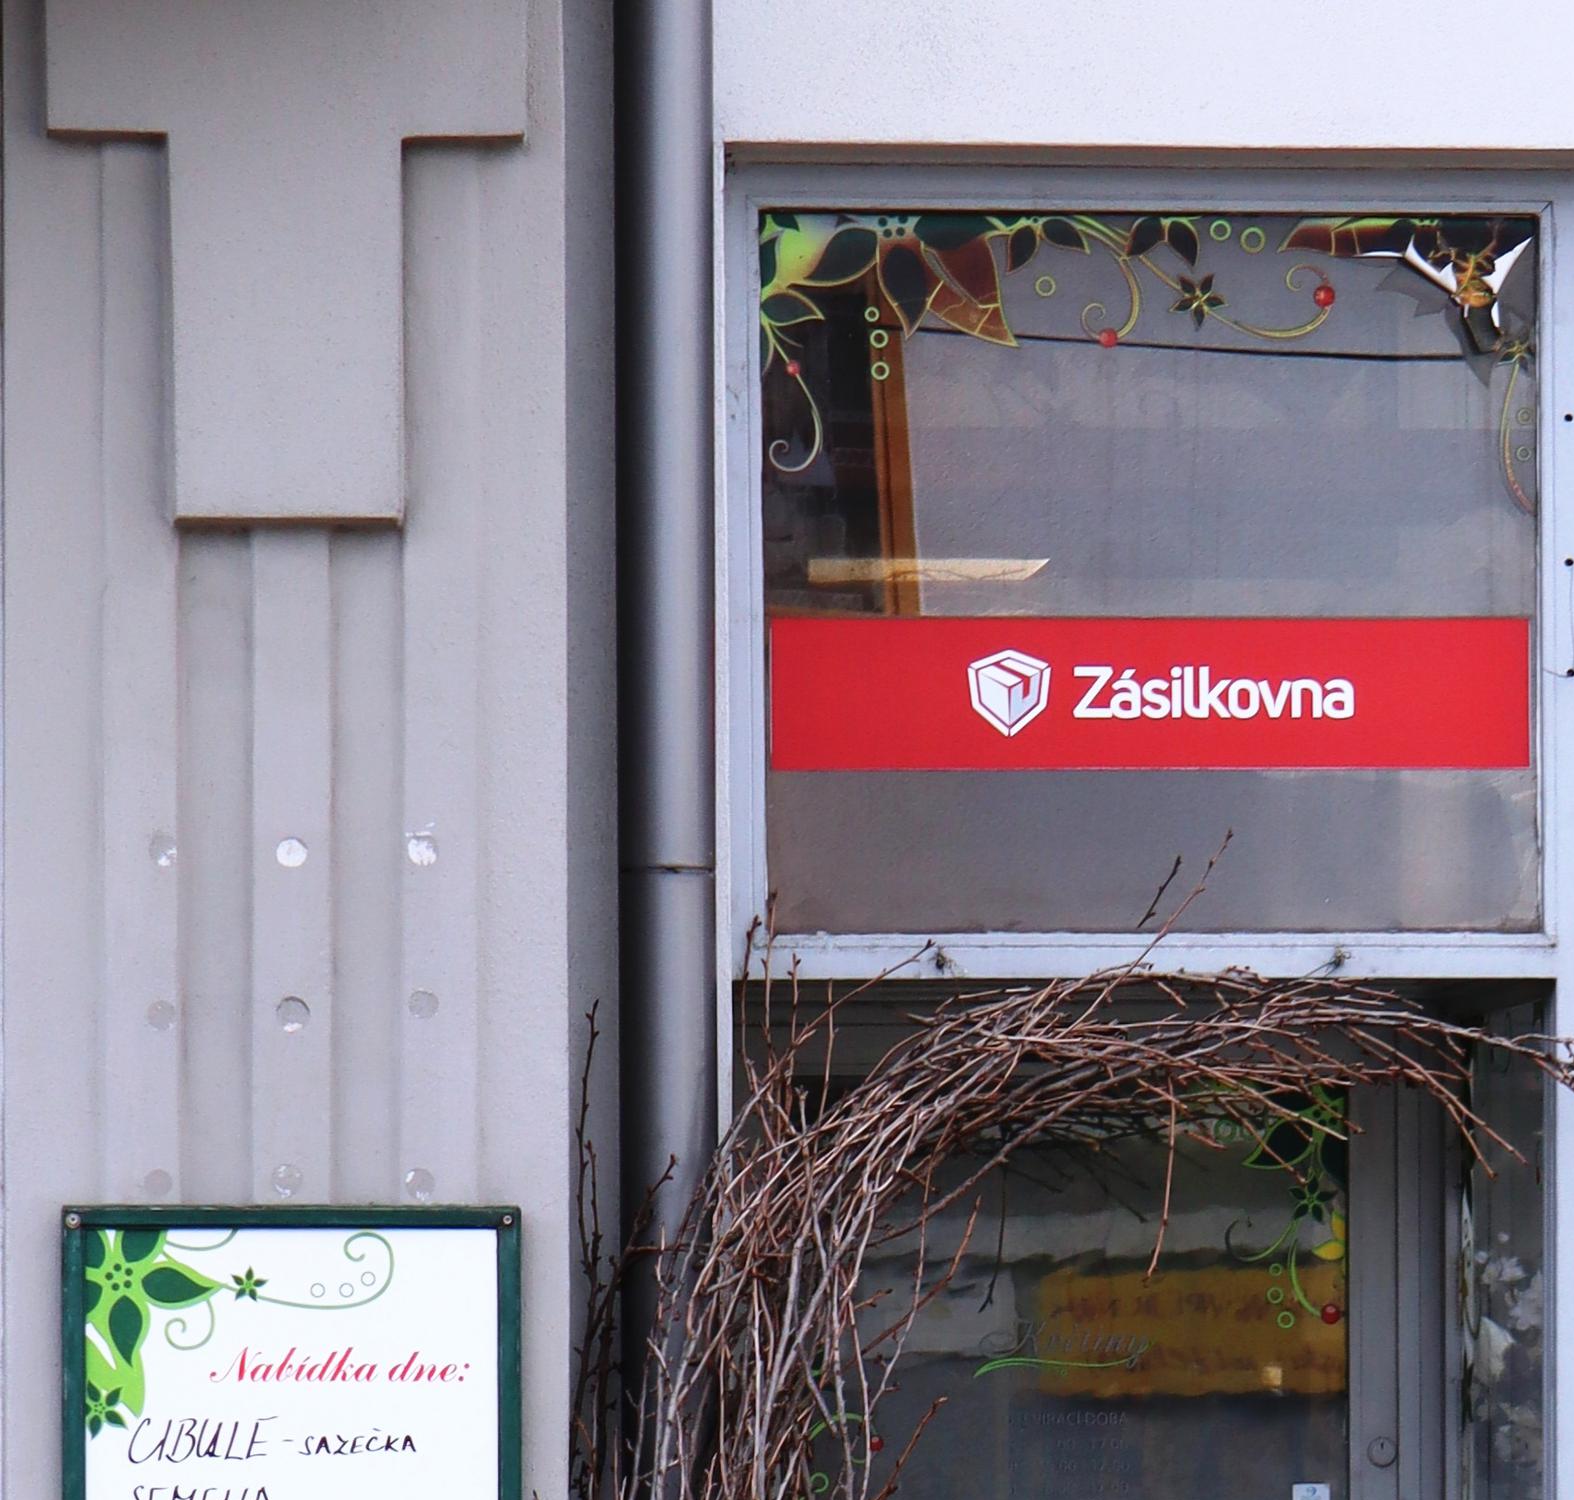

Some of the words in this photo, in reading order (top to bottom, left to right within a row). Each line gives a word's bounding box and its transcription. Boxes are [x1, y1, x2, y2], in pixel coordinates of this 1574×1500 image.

[1072, 666, 1355, 719] Zásilkovna
[210, 1347, 377, 1383] Nabídka
[387, 1351, 469, 1383] dne:
